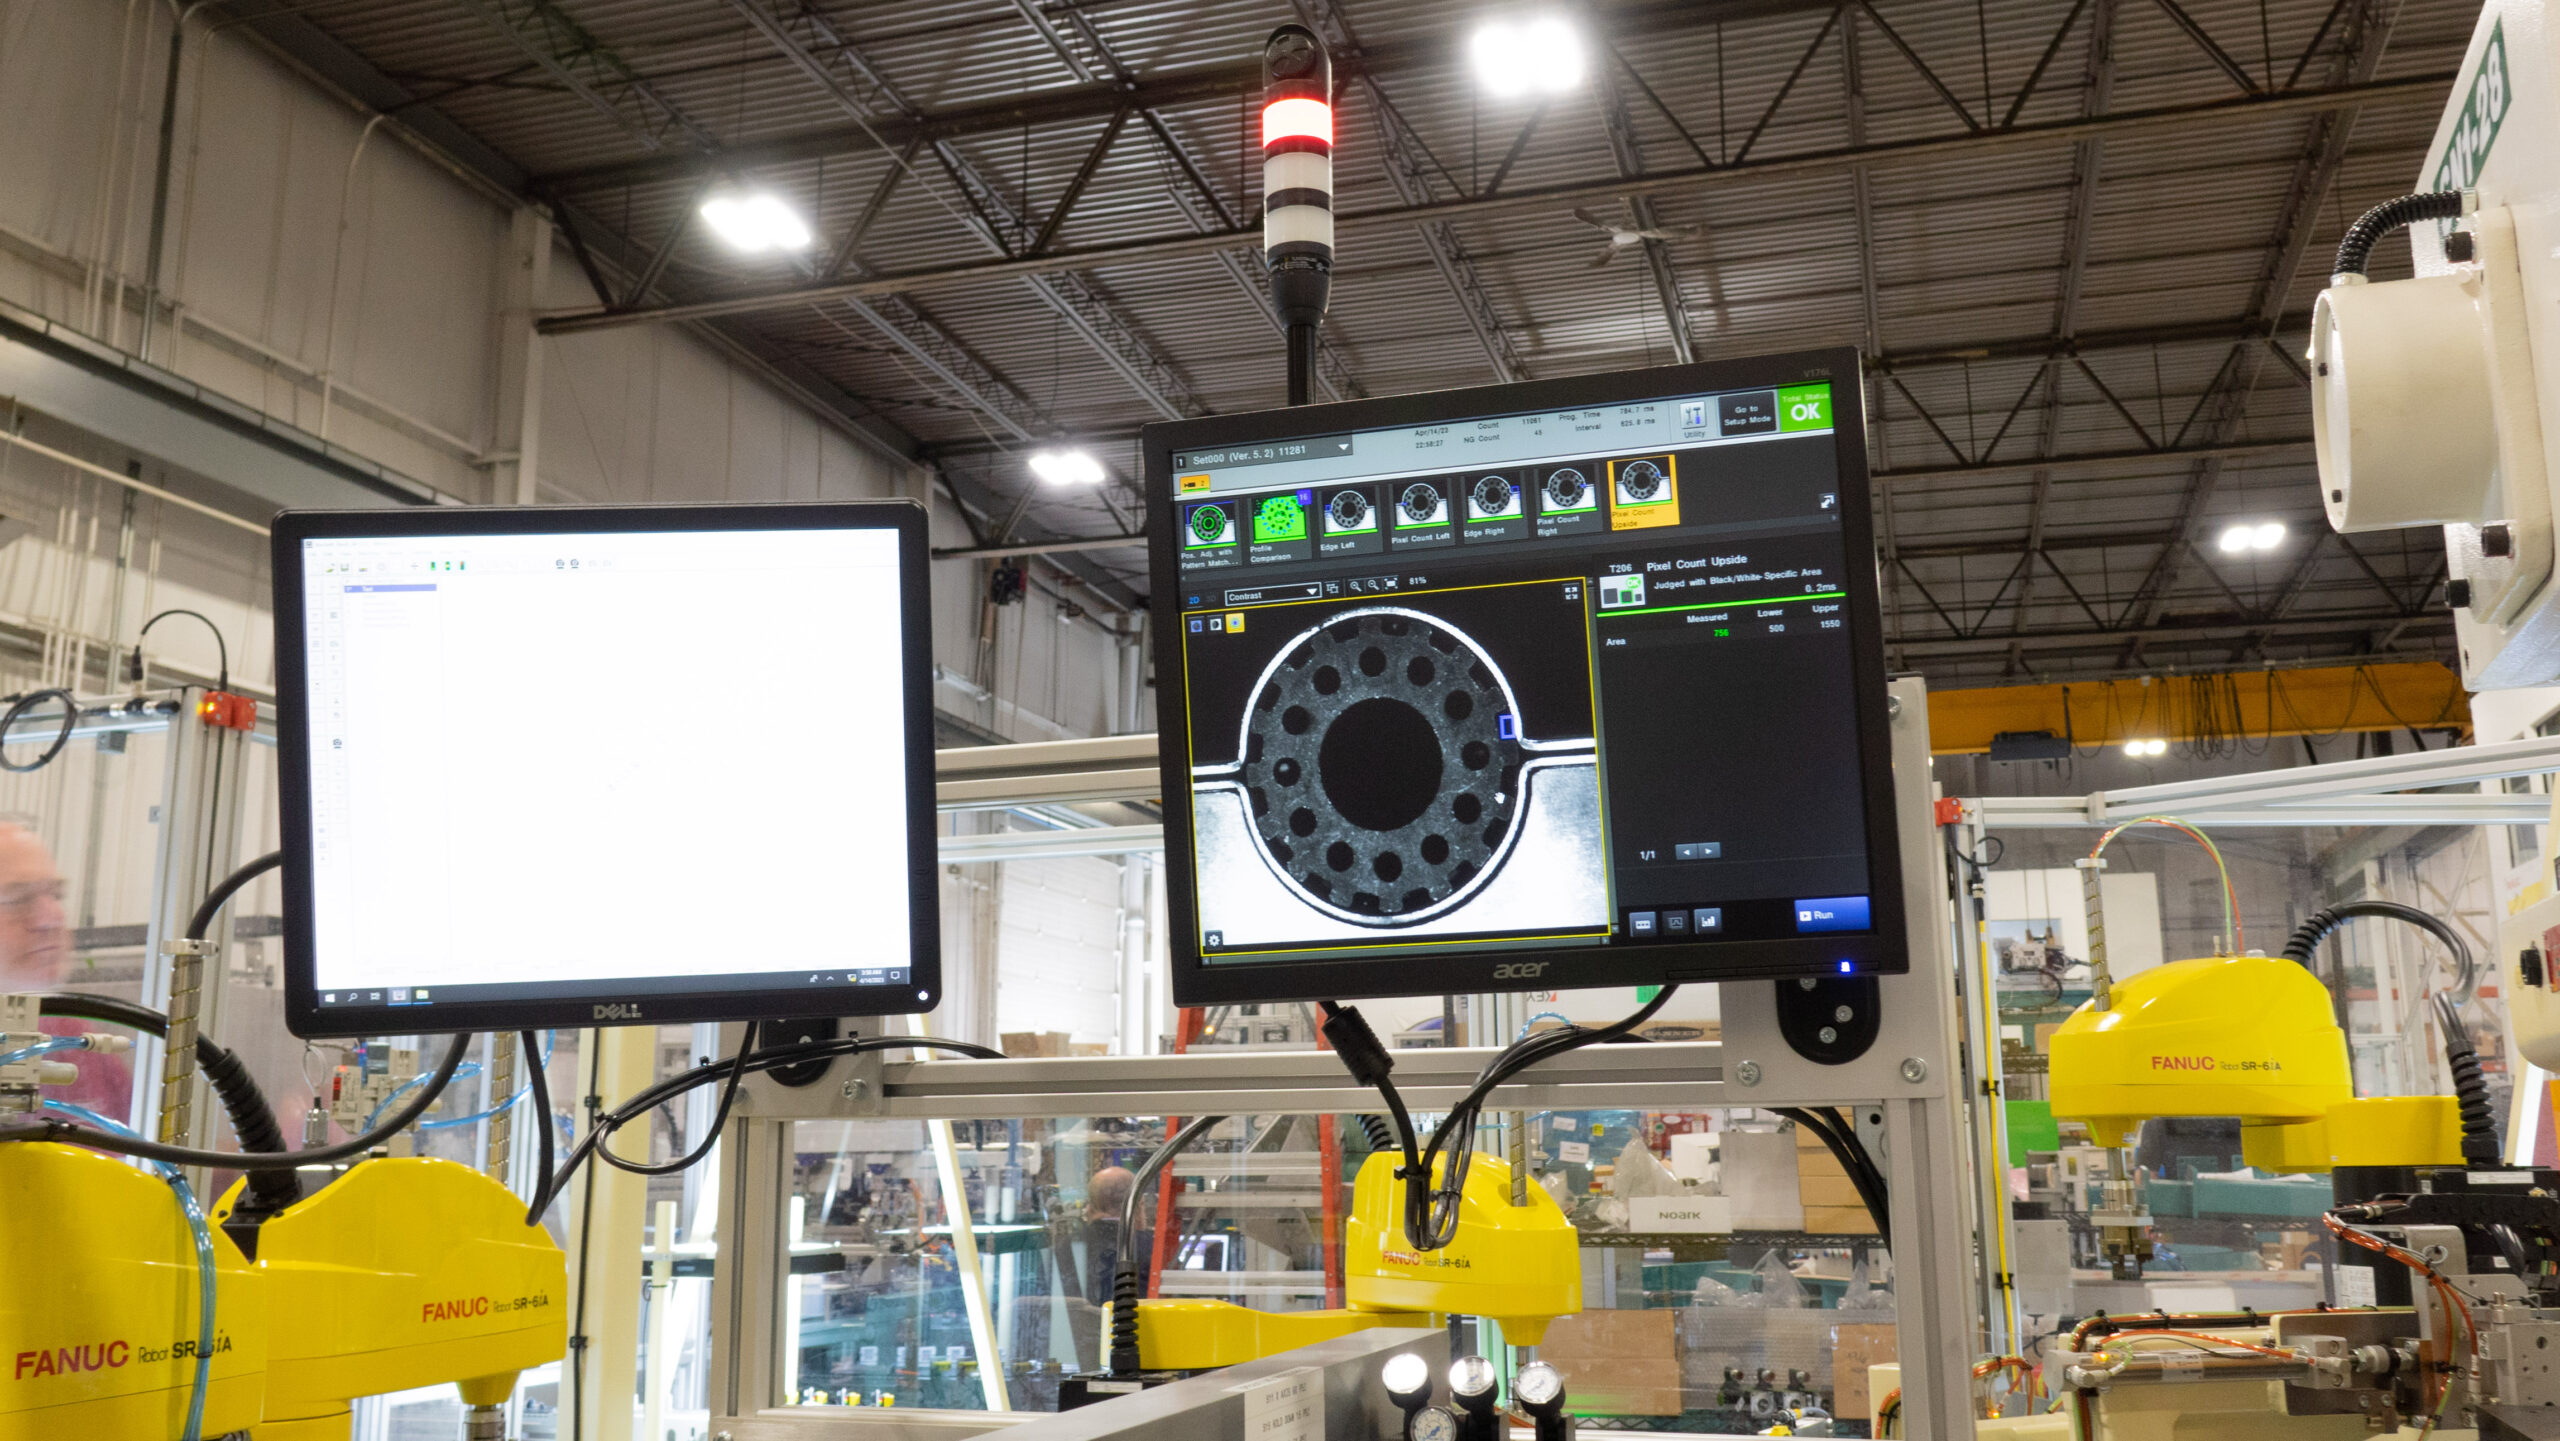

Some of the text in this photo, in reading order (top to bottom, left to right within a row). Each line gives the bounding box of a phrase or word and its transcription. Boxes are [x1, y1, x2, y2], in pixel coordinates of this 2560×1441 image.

[1790, 402, 1821, 422] OK
[1477, 422, 1499, 430] Count
[1724, 416, 1772, 426] Setup Mode
[1464, 436, 1475, 444] NG
[1478, 434, 1500, 442] Count
[1684, 430, 1706, 439] Utility
[1193, 454, 1224, 465] Set000
[1279, 445, 1306, 456] 11281
[1537, 515, 1580, 526] Pixel Count
[1464, 527, 1504, 538] Edge Right
[1537, 527, 1557, 536] Right
[1320, 543, 1338, 552] Edge
[1250, 553, 1291, 563] Comparison
[1609, 554, 1748, 573] T206 Pixel Count Upside
[1182, 561, 1205, 569] Pattern
[1654, 580, 1685, 590] Judged
[1689, 577, 1706, 587] with
[1801, 568, 1822, 576] Area
[1229, 592, 1262, 601] Contrast
[1687, 604, 1839, 623] Measured Lower Upper
[1606, 637, 1626, 646] Area
[1769, 624, 1784, 632] 500
[1820, 620, 1841, 628] 1550
[1640, 850, 1656, 861] 1/1
[1814, 910, 1834, 919] Run
[1493, 962, 1550, 979] acer
[593, 1003, 642, 1020] DELL
[2152, 1056, 2215, 1071] FANUC
[2241, 1058, 2282, 1071] SR-6iA
[1382, 1251, 1420, 1266] FANUC
[422, 1296, 489, 1323] FANUC
[513, 1289, 549, 1311] SR-6iA
[14, 1340, 129, 1380] FANUC
[138, 1346, 169, 1364] Robot
